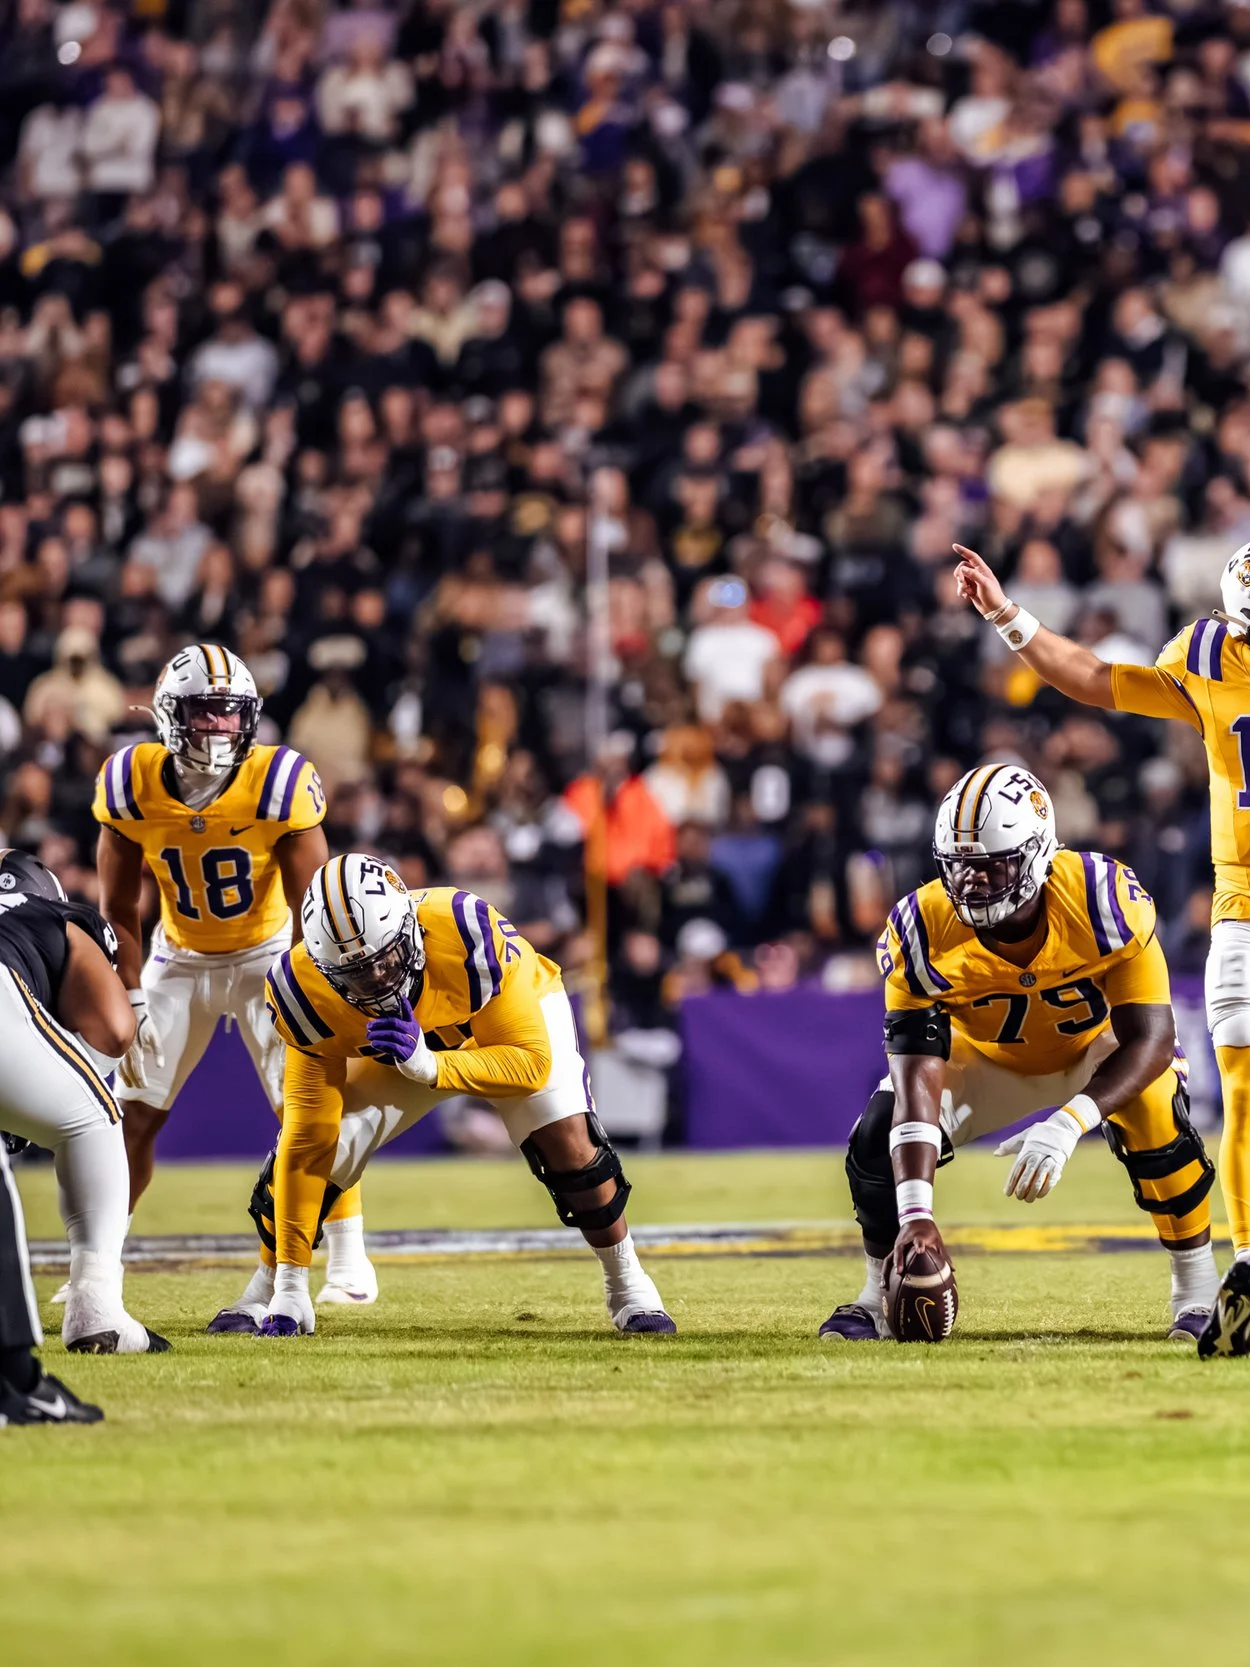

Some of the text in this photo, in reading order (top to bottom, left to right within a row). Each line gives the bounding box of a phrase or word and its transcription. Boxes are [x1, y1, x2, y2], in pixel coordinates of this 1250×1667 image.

[954, 845, 974, 853] LSU
[159, 846, 255, 921] 18
[970, 976, 1110, 1044] 79
